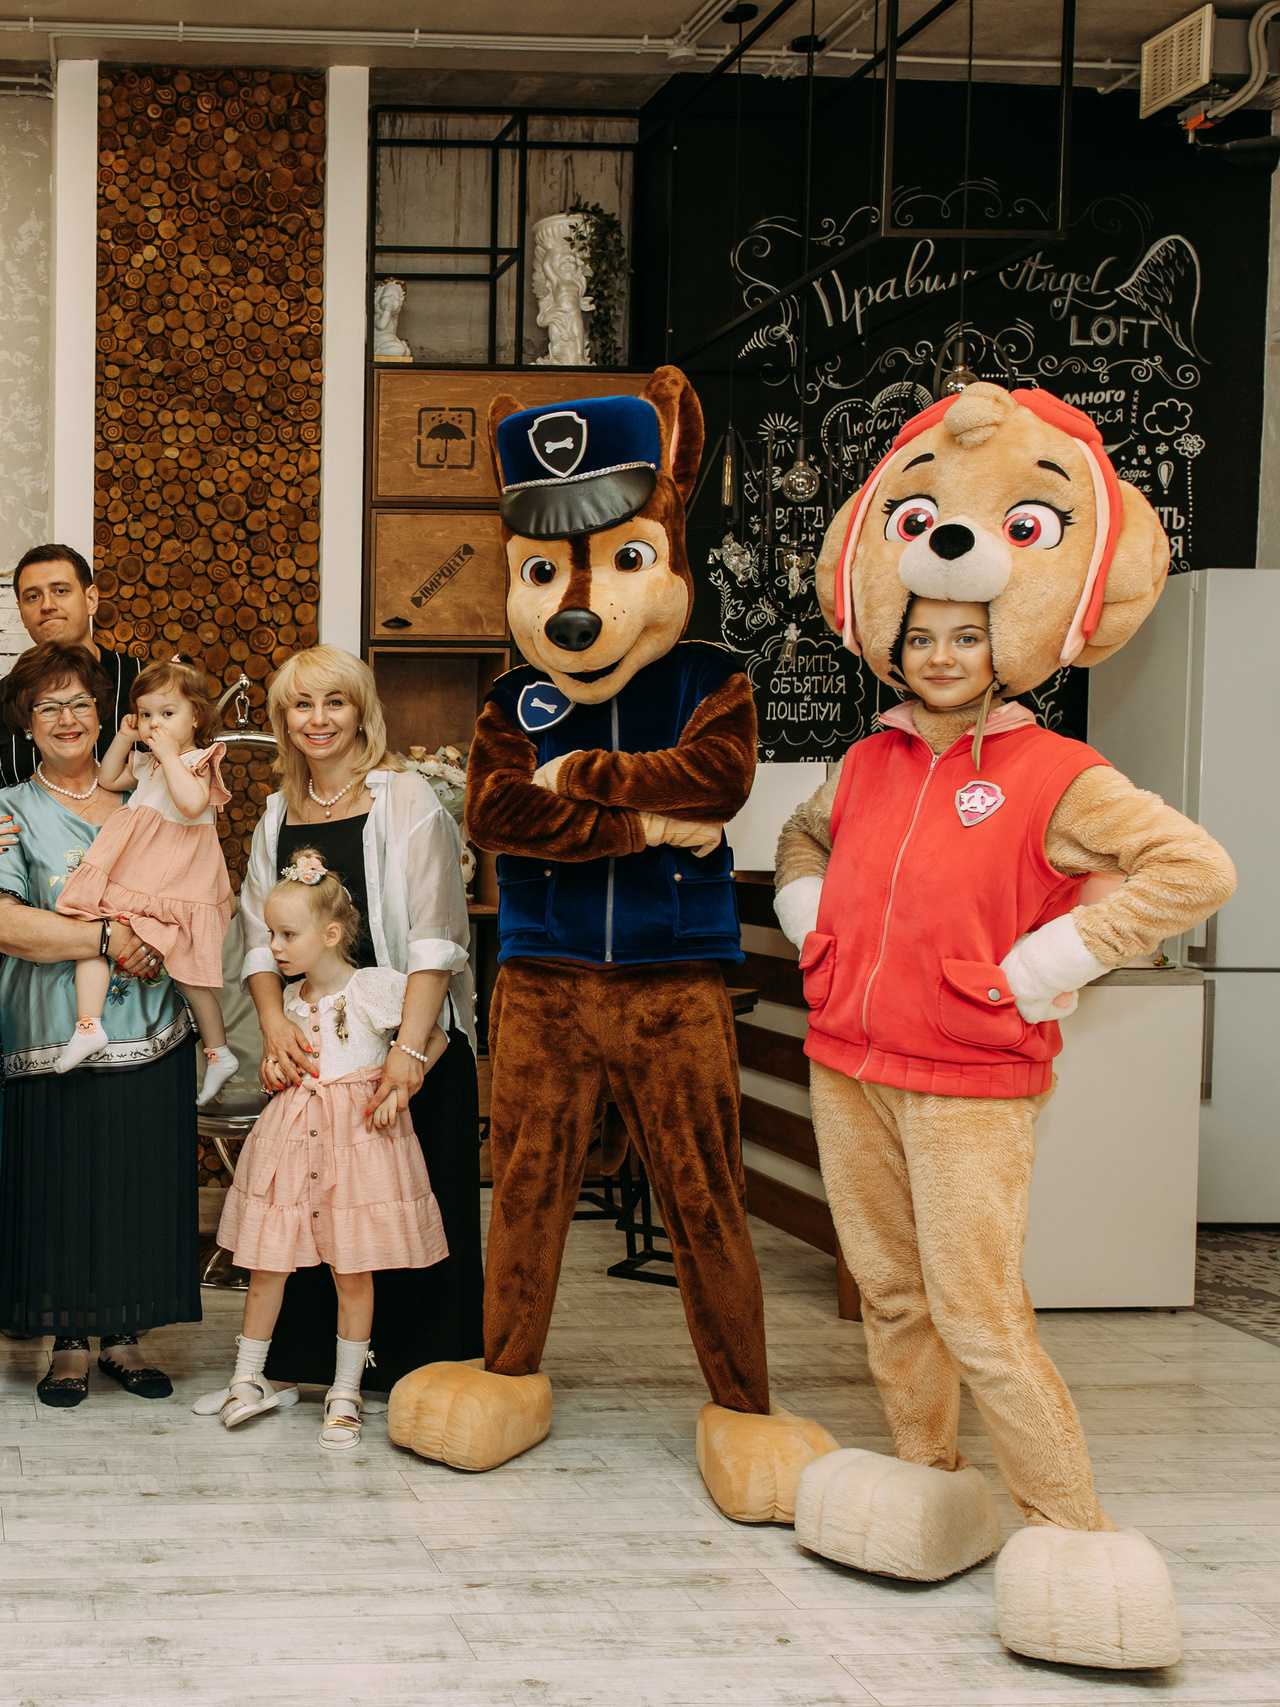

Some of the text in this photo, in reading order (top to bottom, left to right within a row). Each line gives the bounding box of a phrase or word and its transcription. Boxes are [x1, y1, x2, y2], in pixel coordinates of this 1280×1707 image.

[1070, 315, 1159, 348] LOFT
[419, 551, 467, 600] IMPORT
[773, 653, 840, 675] ДАРИТЬ
[770, 674, 847, 694] ОБЪЯТИЯ
[766, 701, 841, 723] ПОЦЕЛУИ
